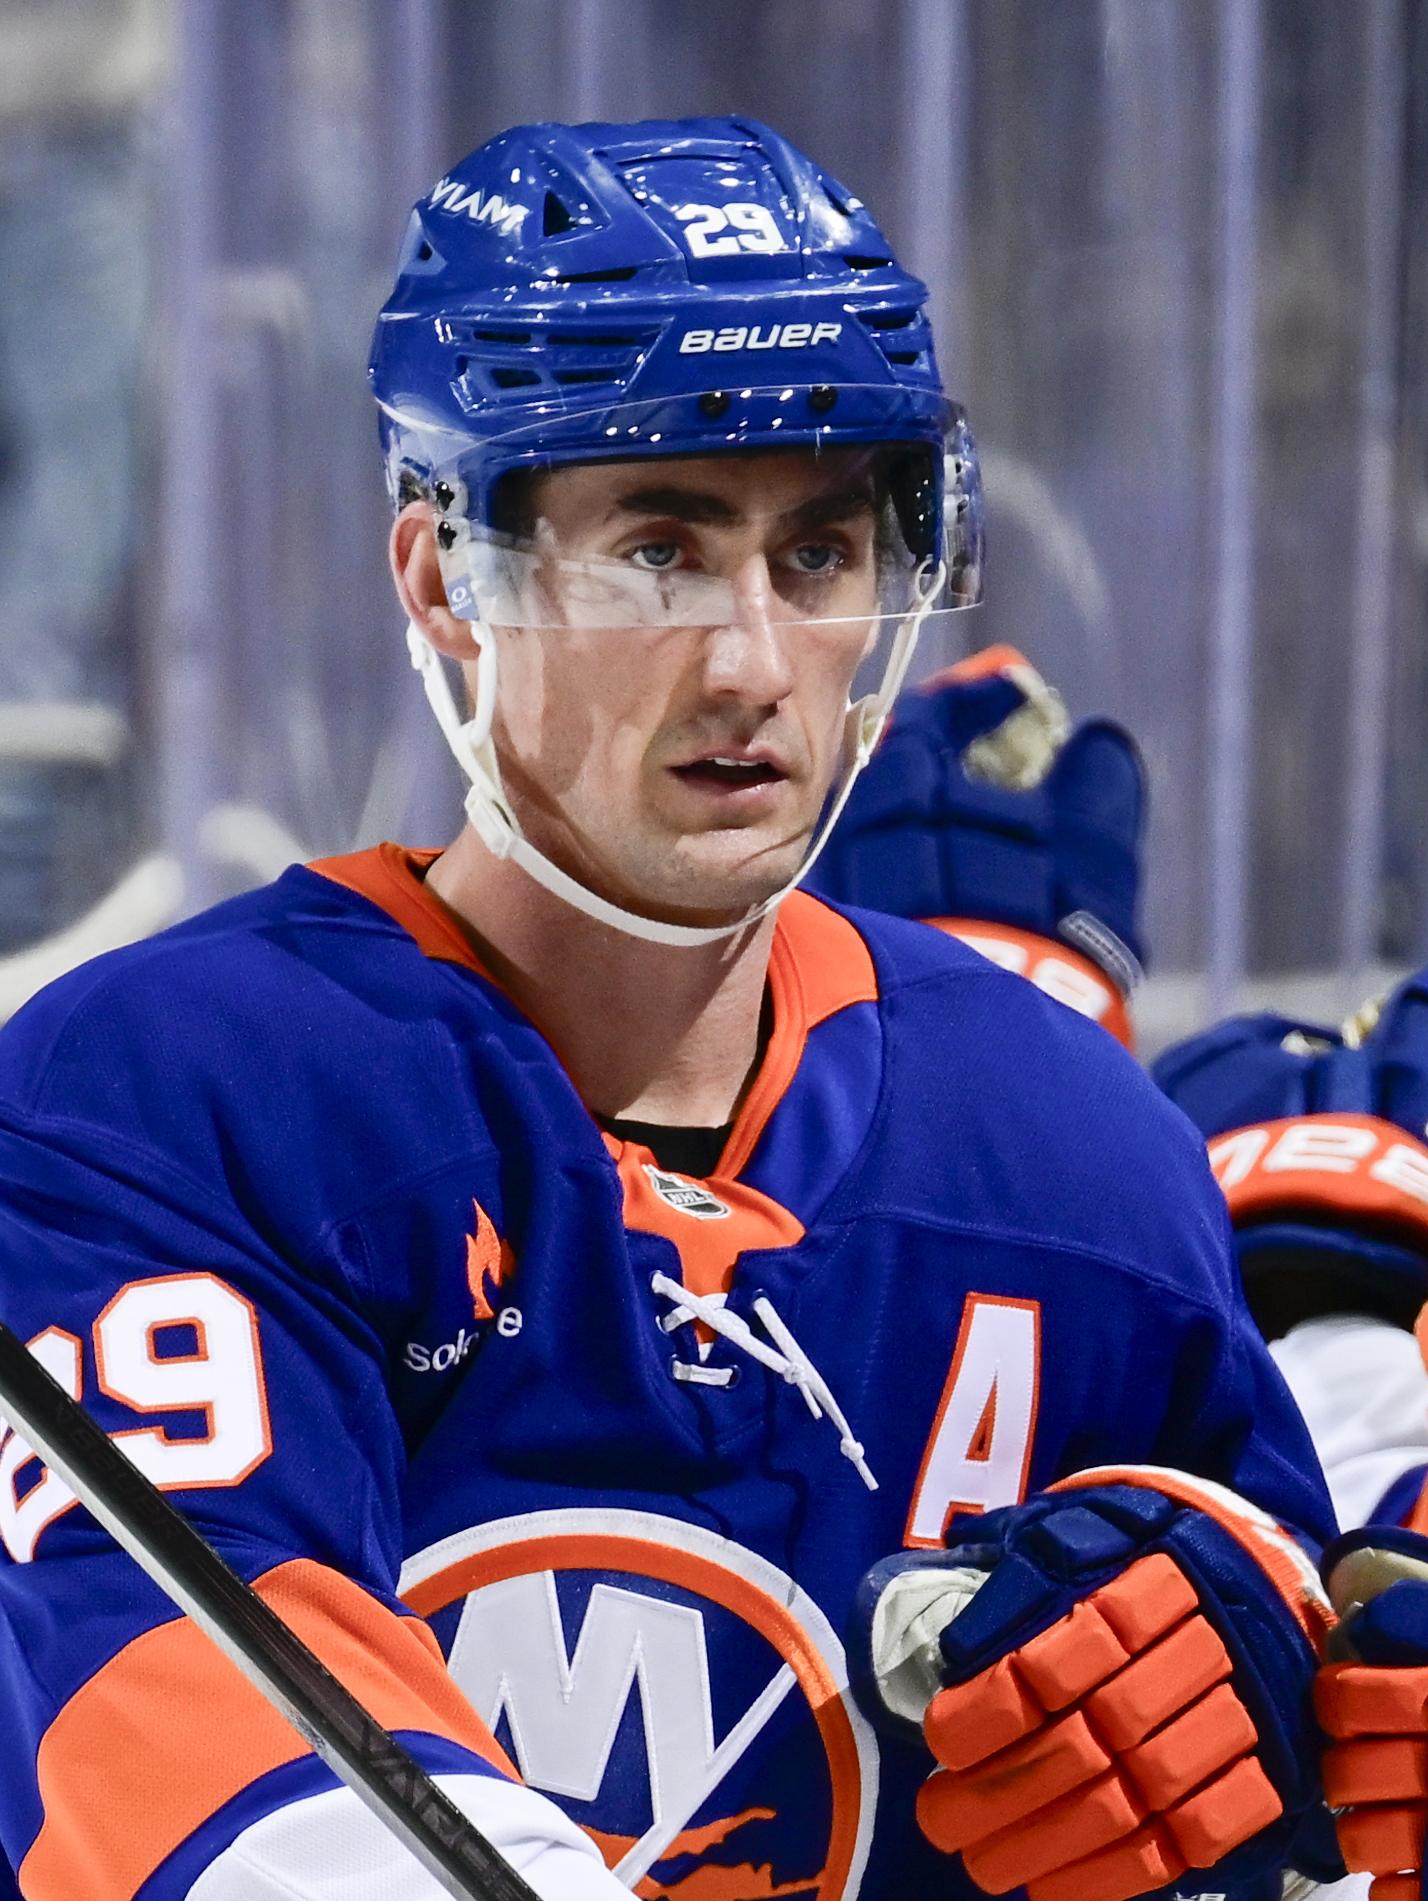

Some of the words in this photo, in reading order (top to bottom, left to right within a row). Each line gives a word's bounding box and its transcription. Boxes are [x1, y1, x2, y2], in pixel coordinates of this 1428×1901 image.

[429, 178, 530, 233] VIAM
[675, 203, 785, 257] 29
[679, 322, 842, 353] BAUER
[903, 1292, 1041, 1548] A
